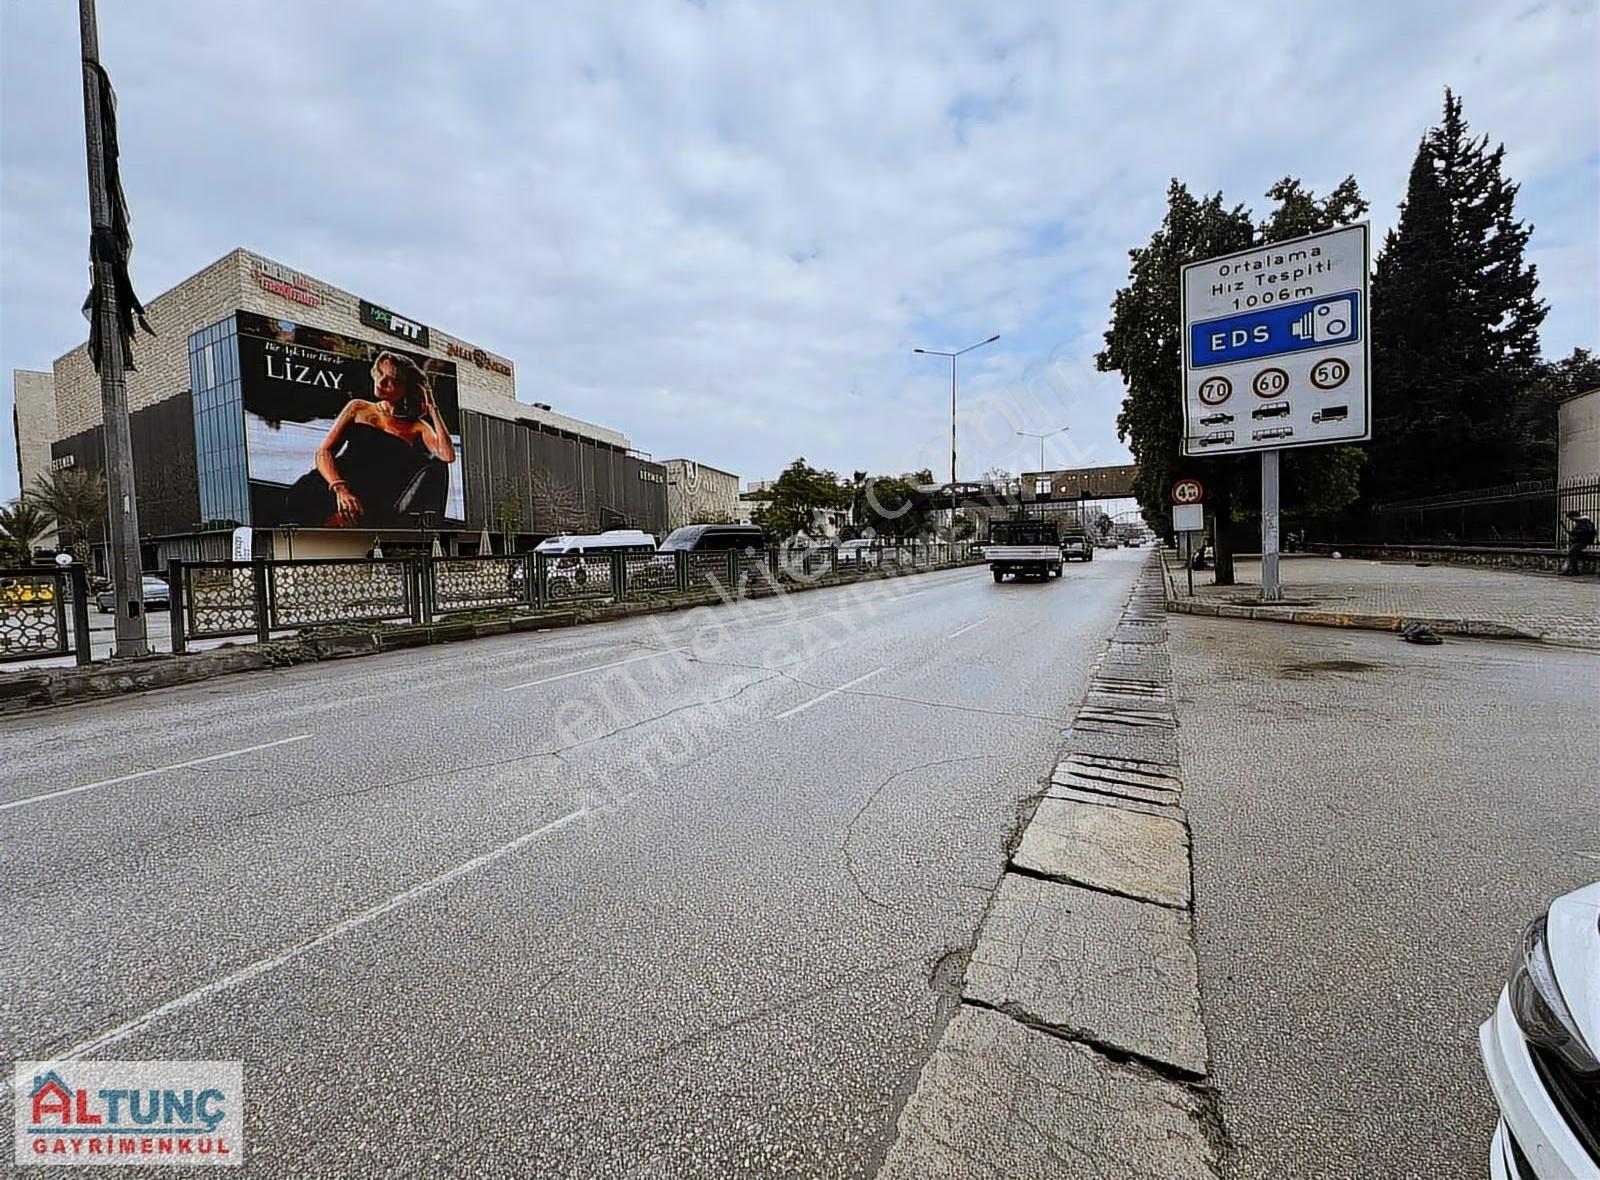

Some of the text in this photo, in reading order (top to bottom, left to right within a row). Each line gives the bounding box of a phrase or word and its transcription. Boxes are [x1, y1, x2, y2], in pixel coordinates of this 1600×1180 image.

[1218, 246, 1322, 277] Ortalama
[1211, 259, 1332, 297] Hız Tespiti
[1232, 285, 1314, 310] 1006m
[1211, 325, 1270, 352] EDS
[1258, 374, 1283, 391] 60
[1317, 365, 1343, 382] 50
[1204, 382, 1227, 400] 70
